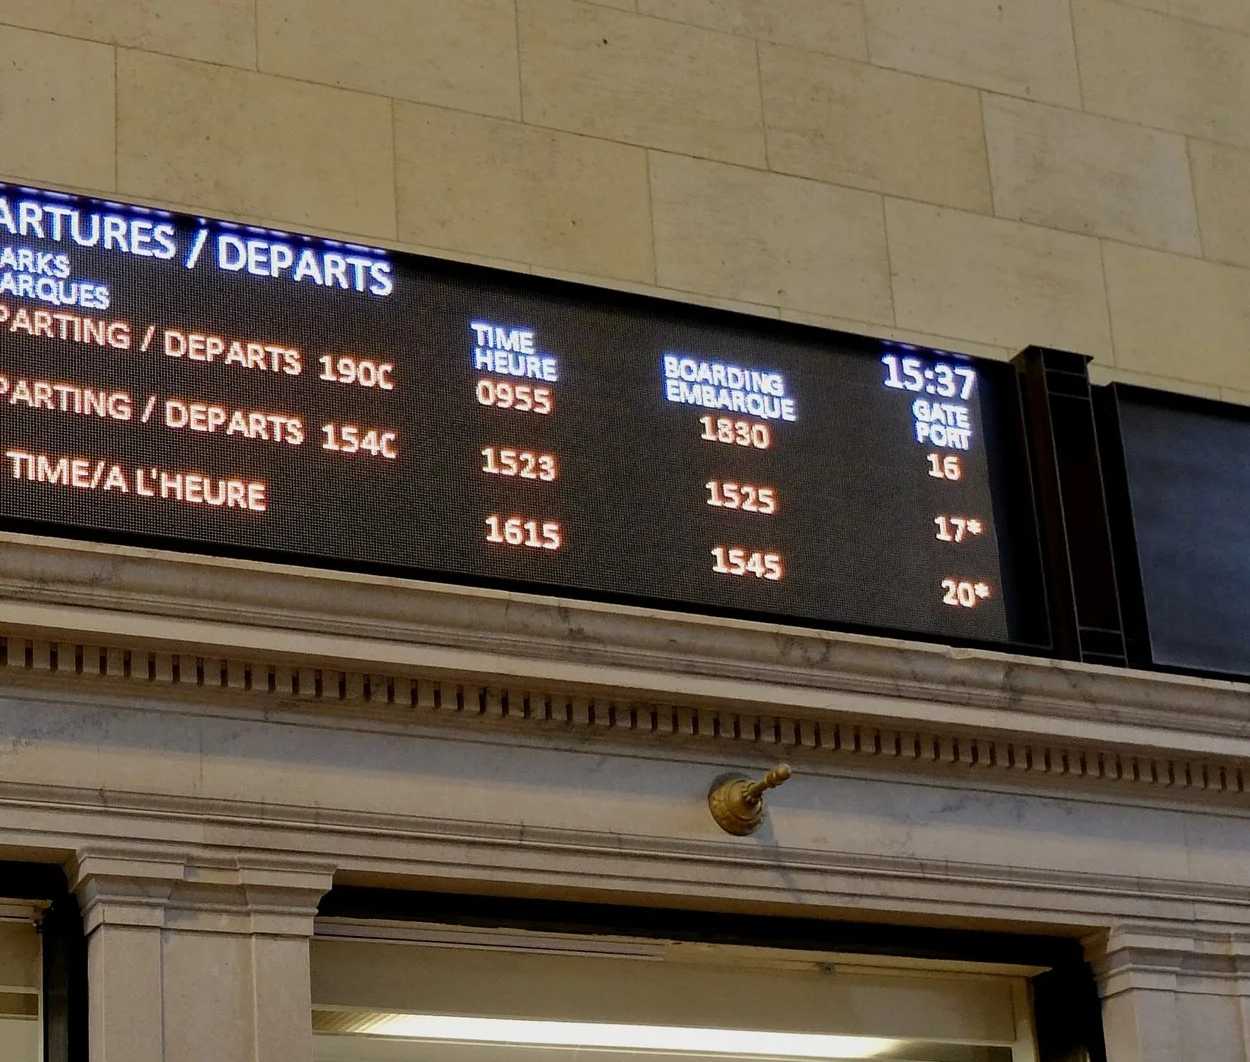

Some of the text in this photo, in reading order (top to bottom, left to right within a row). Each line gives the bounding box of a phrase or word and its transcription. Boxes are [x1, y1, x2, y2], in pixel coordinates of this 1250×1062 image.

[185, 222, 212, 270] /
[216, 235, 394, 297] DEPARTS
[140, 324, 155, 353] /
[164, 330, 302, 376] DEPARTS
[470, 321, 534, 355] TIME
[473, 350, 558, 382] HEURE
[663, 355, 784, 397] BOARDING
[881, 355, 978, 401] 15:37
[476, 380, 552, 415] 0955
[664, 379, 796, 421] EMBARQUE
[911, 400, 969, 429] GATE
[141, 396, 156, 425] /
[165, 400, 304, 446] DEPARTS
[913, 422, 971, 450] PORT
[6, 450, 128, 494] TIME/A
[137, 468, 267, 512] L'HEURE
[480, 447, 558, 482] 1523
[928, 453, 962, 481] 16
[705, 480, 777, 515] 1525
[484, 516, 561, 550] 1615
[711, 547, 783, 581] 1545
